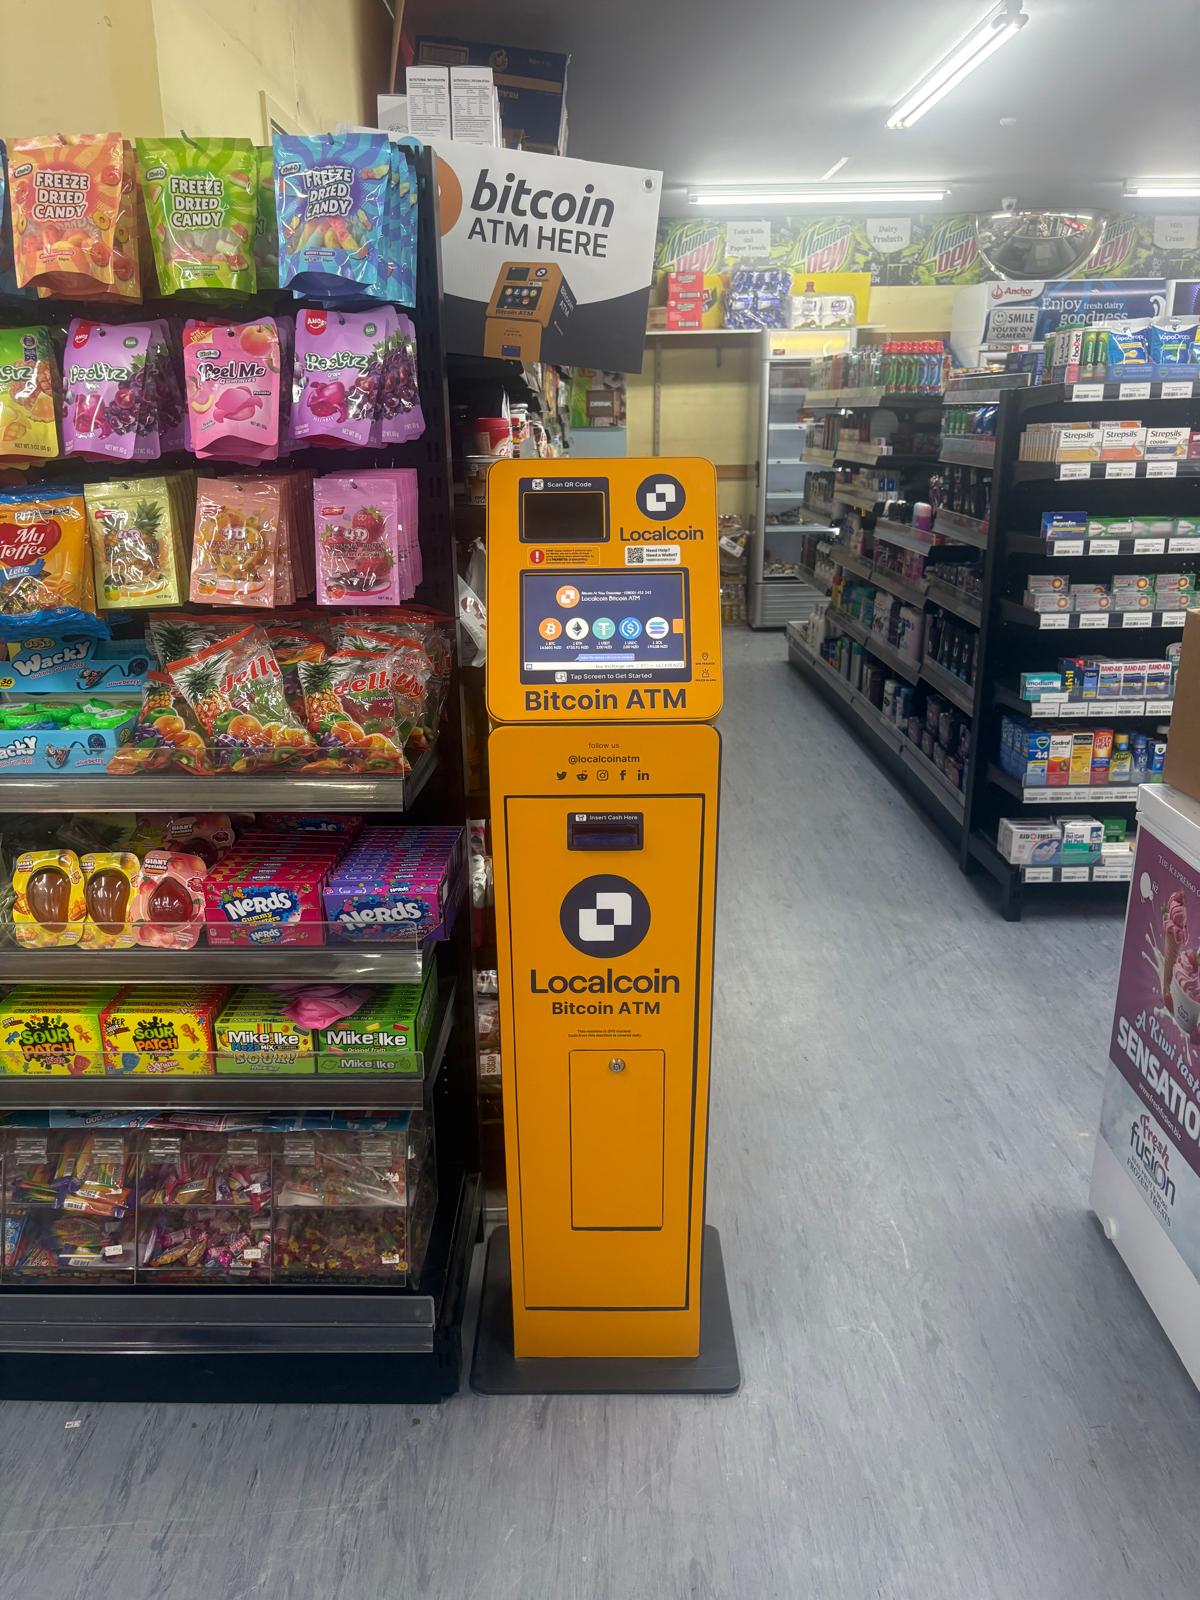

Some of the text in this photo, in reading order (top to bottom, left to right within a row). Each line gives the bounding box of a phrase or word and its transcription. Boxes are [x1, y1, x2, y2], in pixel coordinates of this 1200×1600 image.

[35, 173, 88, 190] FREEZE
[306, 168, 352, 188] FREEZE
[170, 178, 222, 195] FREEZE
[310, 184, 348, 202] DRIED
[38, 189, 84, 204] DRIED
[174, 196, 218, 211] DRIED
[470, 169, 614, 228] bitcoin
[34, 204, 86, 219] CANDY
[306, 200, 352, 217] CANDY
[172, 212, 223, 227] CANDY
[878, 224, 898, 233] Dairy
[468, 218, 608, 258] ATM HERE
[872, 235, 904, 244] Products
[1004, 287, 1034, 296] Anchor
[1042, 298, 1082, 312] Enjoy
[1104, 302, 1124, 310] dairy
[1008, 313, 1035, 323] SMILE
[1060, 311, 1128, 325] goodness
[198, 362, 265, 382] Peel Me
[1063, 431, 1094, 440] Strepsils
[1106, 430, 1138, 439] Strepsils
[1150, 430, 1182, 439] Strepsils
[14, 527, 44, 544] My
[620, 526, 704, 542] Localcoin
[0, 543, 46, 560] Toffee
[12, 642, 91, 676] Wacky
[218, 656, 282, 694] Jelly
[525, 688, 686, 711] Bitcoin ATM
[568, 755, 640, 765] @localcoinatm
[1036, 750, 1048, 759] 44
[144, 858, 168, 866] GIANT
[530, 968, 680, 994] Localcoin
[552, 1002, 660, 1014] Bitcoin ATM
[21, 1028, 70, 1044] SOUR
[135, 1026, 174, 1040] SOUR
[228, 1031, 299, 1045] Mike Ike
[326, 1031, 407, 1046] Mike Ike
[1149, 1015, 1176, 1060] Kiwi
[22, 1042, 76, 1061] PATCH
[136, 1037, 178, 1051] PATCH
[235, 1052, 297, 1064] SOUR!
[341, 1060, 395, 1068] Mike Ike
[1117, 1016, 1200, 1145] SENSATIO
[1140, 1113, 1170, 1172] fresh
[1130, 1122, 1176, 1206] fusion
[1150, 1190, 1171, 1227] TREATS
